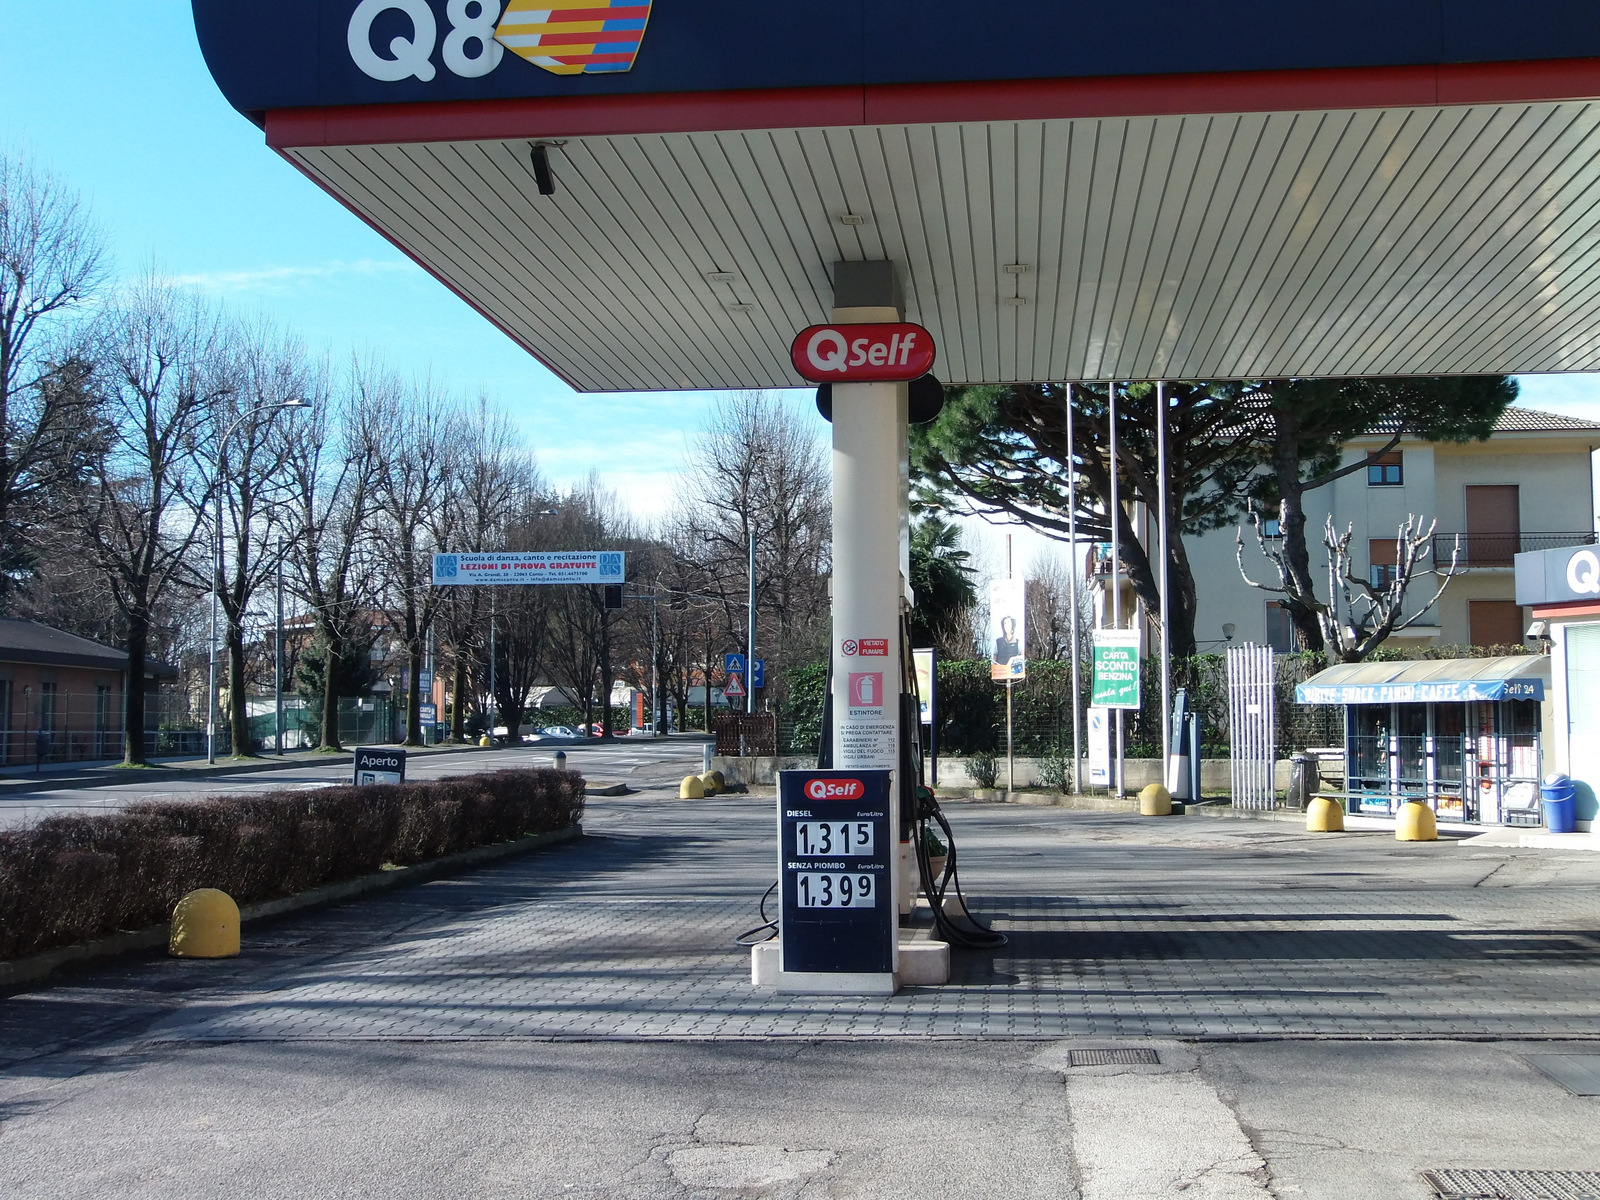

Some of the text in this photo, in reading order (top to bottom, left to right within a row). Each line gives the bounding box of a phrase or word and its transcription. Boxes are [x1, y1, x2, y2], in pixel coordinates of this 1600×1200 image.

[347, 0, 504, 82] Q8
[806, 329, 917, 373] QSelf
[460, 563, 498, 571] LEZIONI
[1566, 549, 1600, 594] Q
[1102, 651, 1129, 660] CARTA
[1095, 661, 1137, 671] SCONTO
[1098, 672, 1134, 681] BENZINA
[1342, 687, 1374, 702] SNACK
[1524, 684, 1535, 695] 24
[360, 755, 399, 768] Aperto
[810, 780, 857, 799] QSelf
[799, 823, 870, 854] 1,315
[799, 875, 872, 907] 1,399
